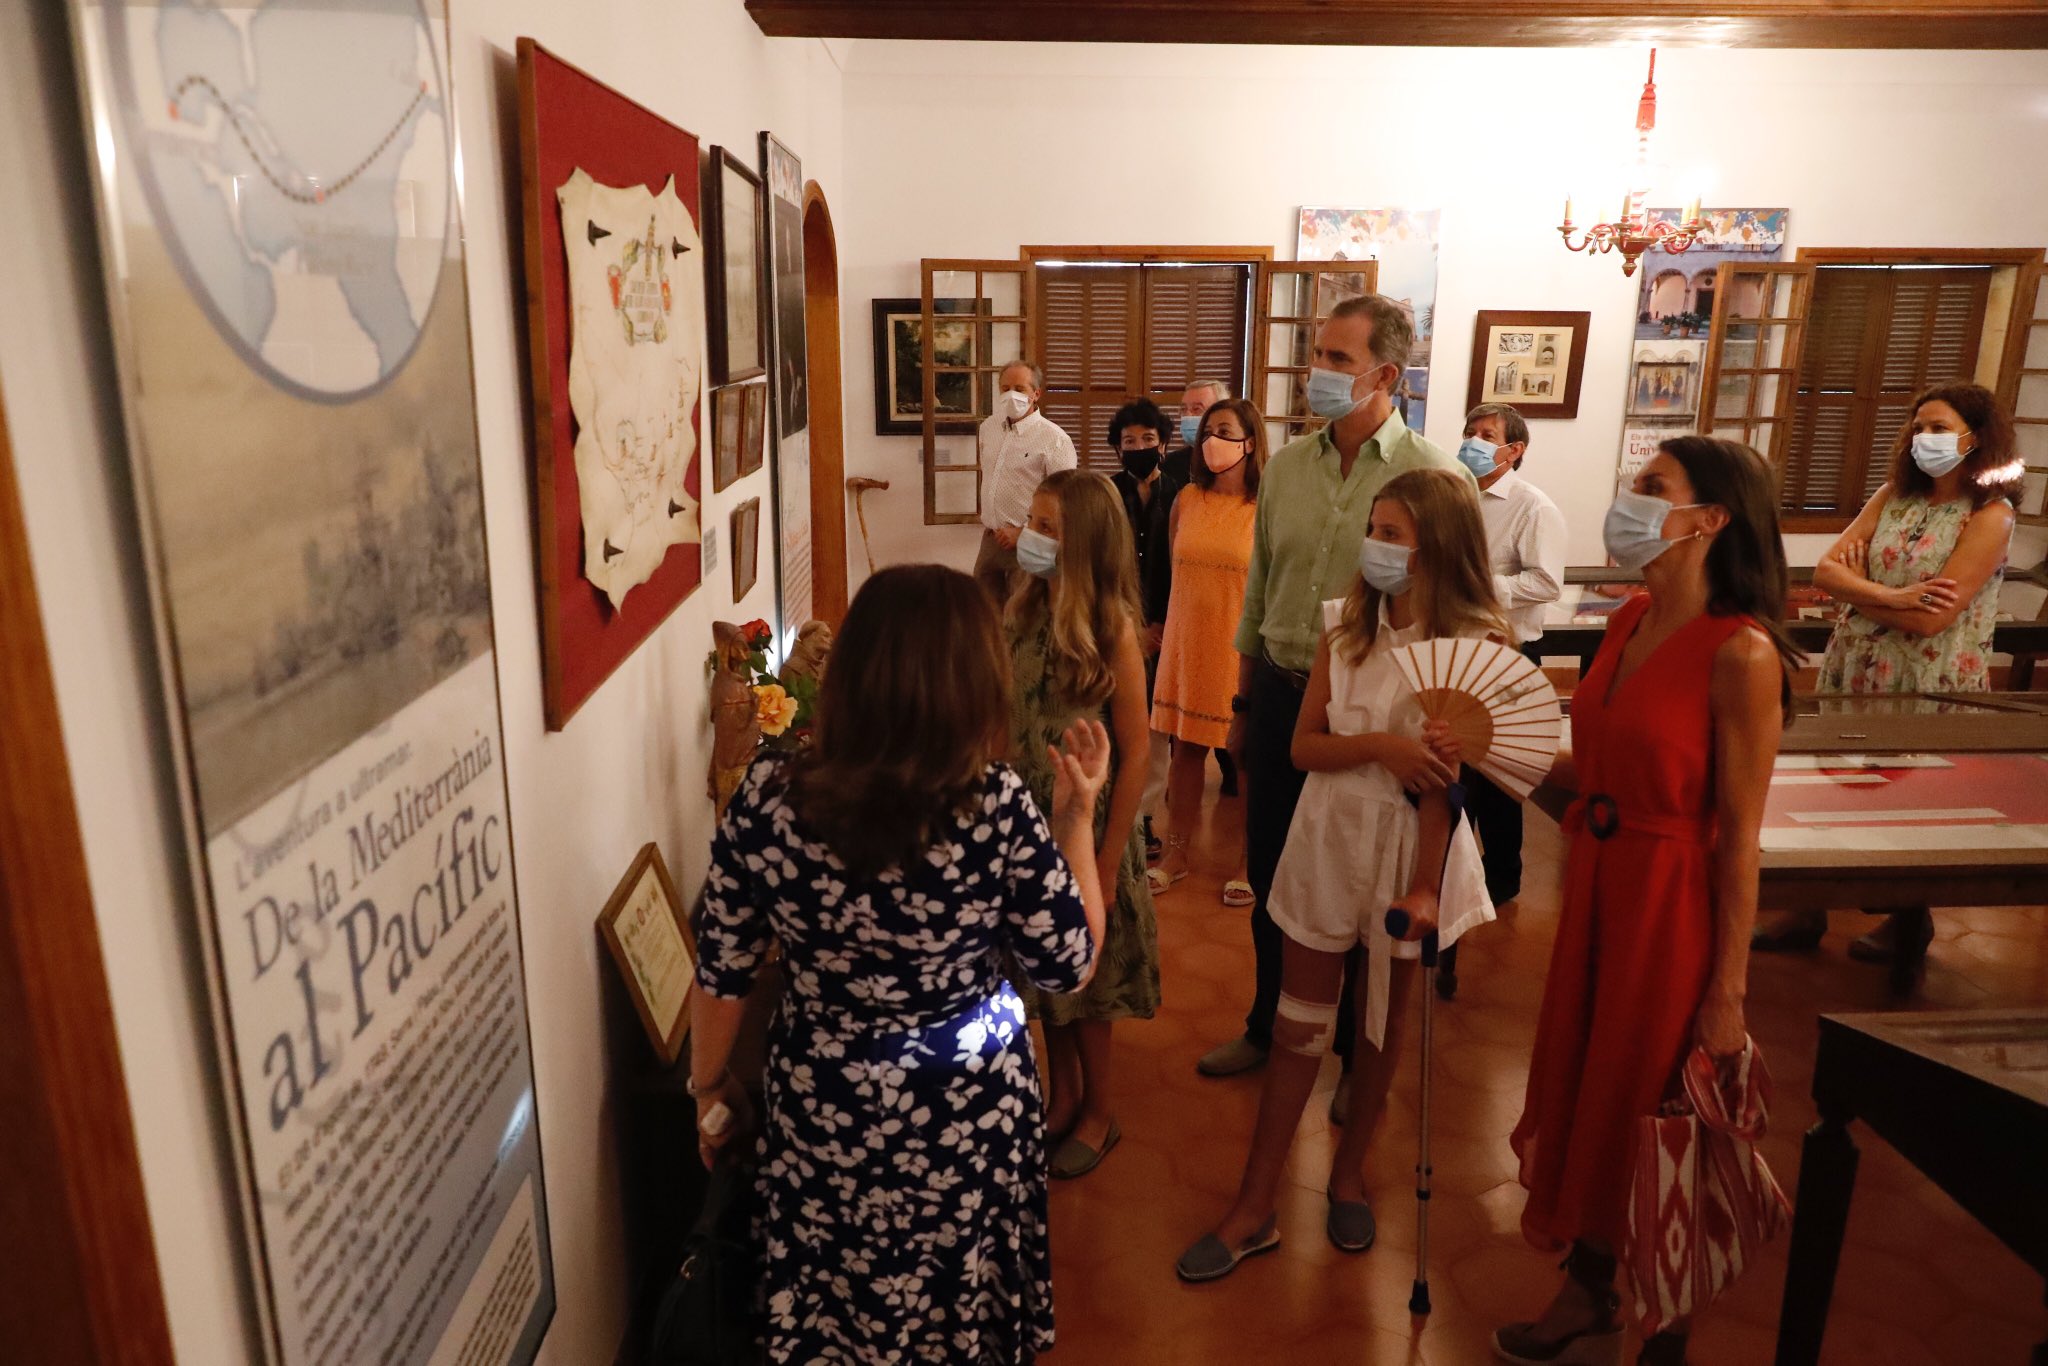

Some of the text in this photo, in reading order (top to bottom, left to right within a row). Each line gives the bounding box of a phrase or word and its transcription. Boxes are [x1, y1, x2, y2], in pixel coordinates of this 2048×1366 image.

[243, 729, 493, 981] De la Mediterrània
[263, 957, 332, 1133] al
[336, 804, 502, 1041] Pacífic
